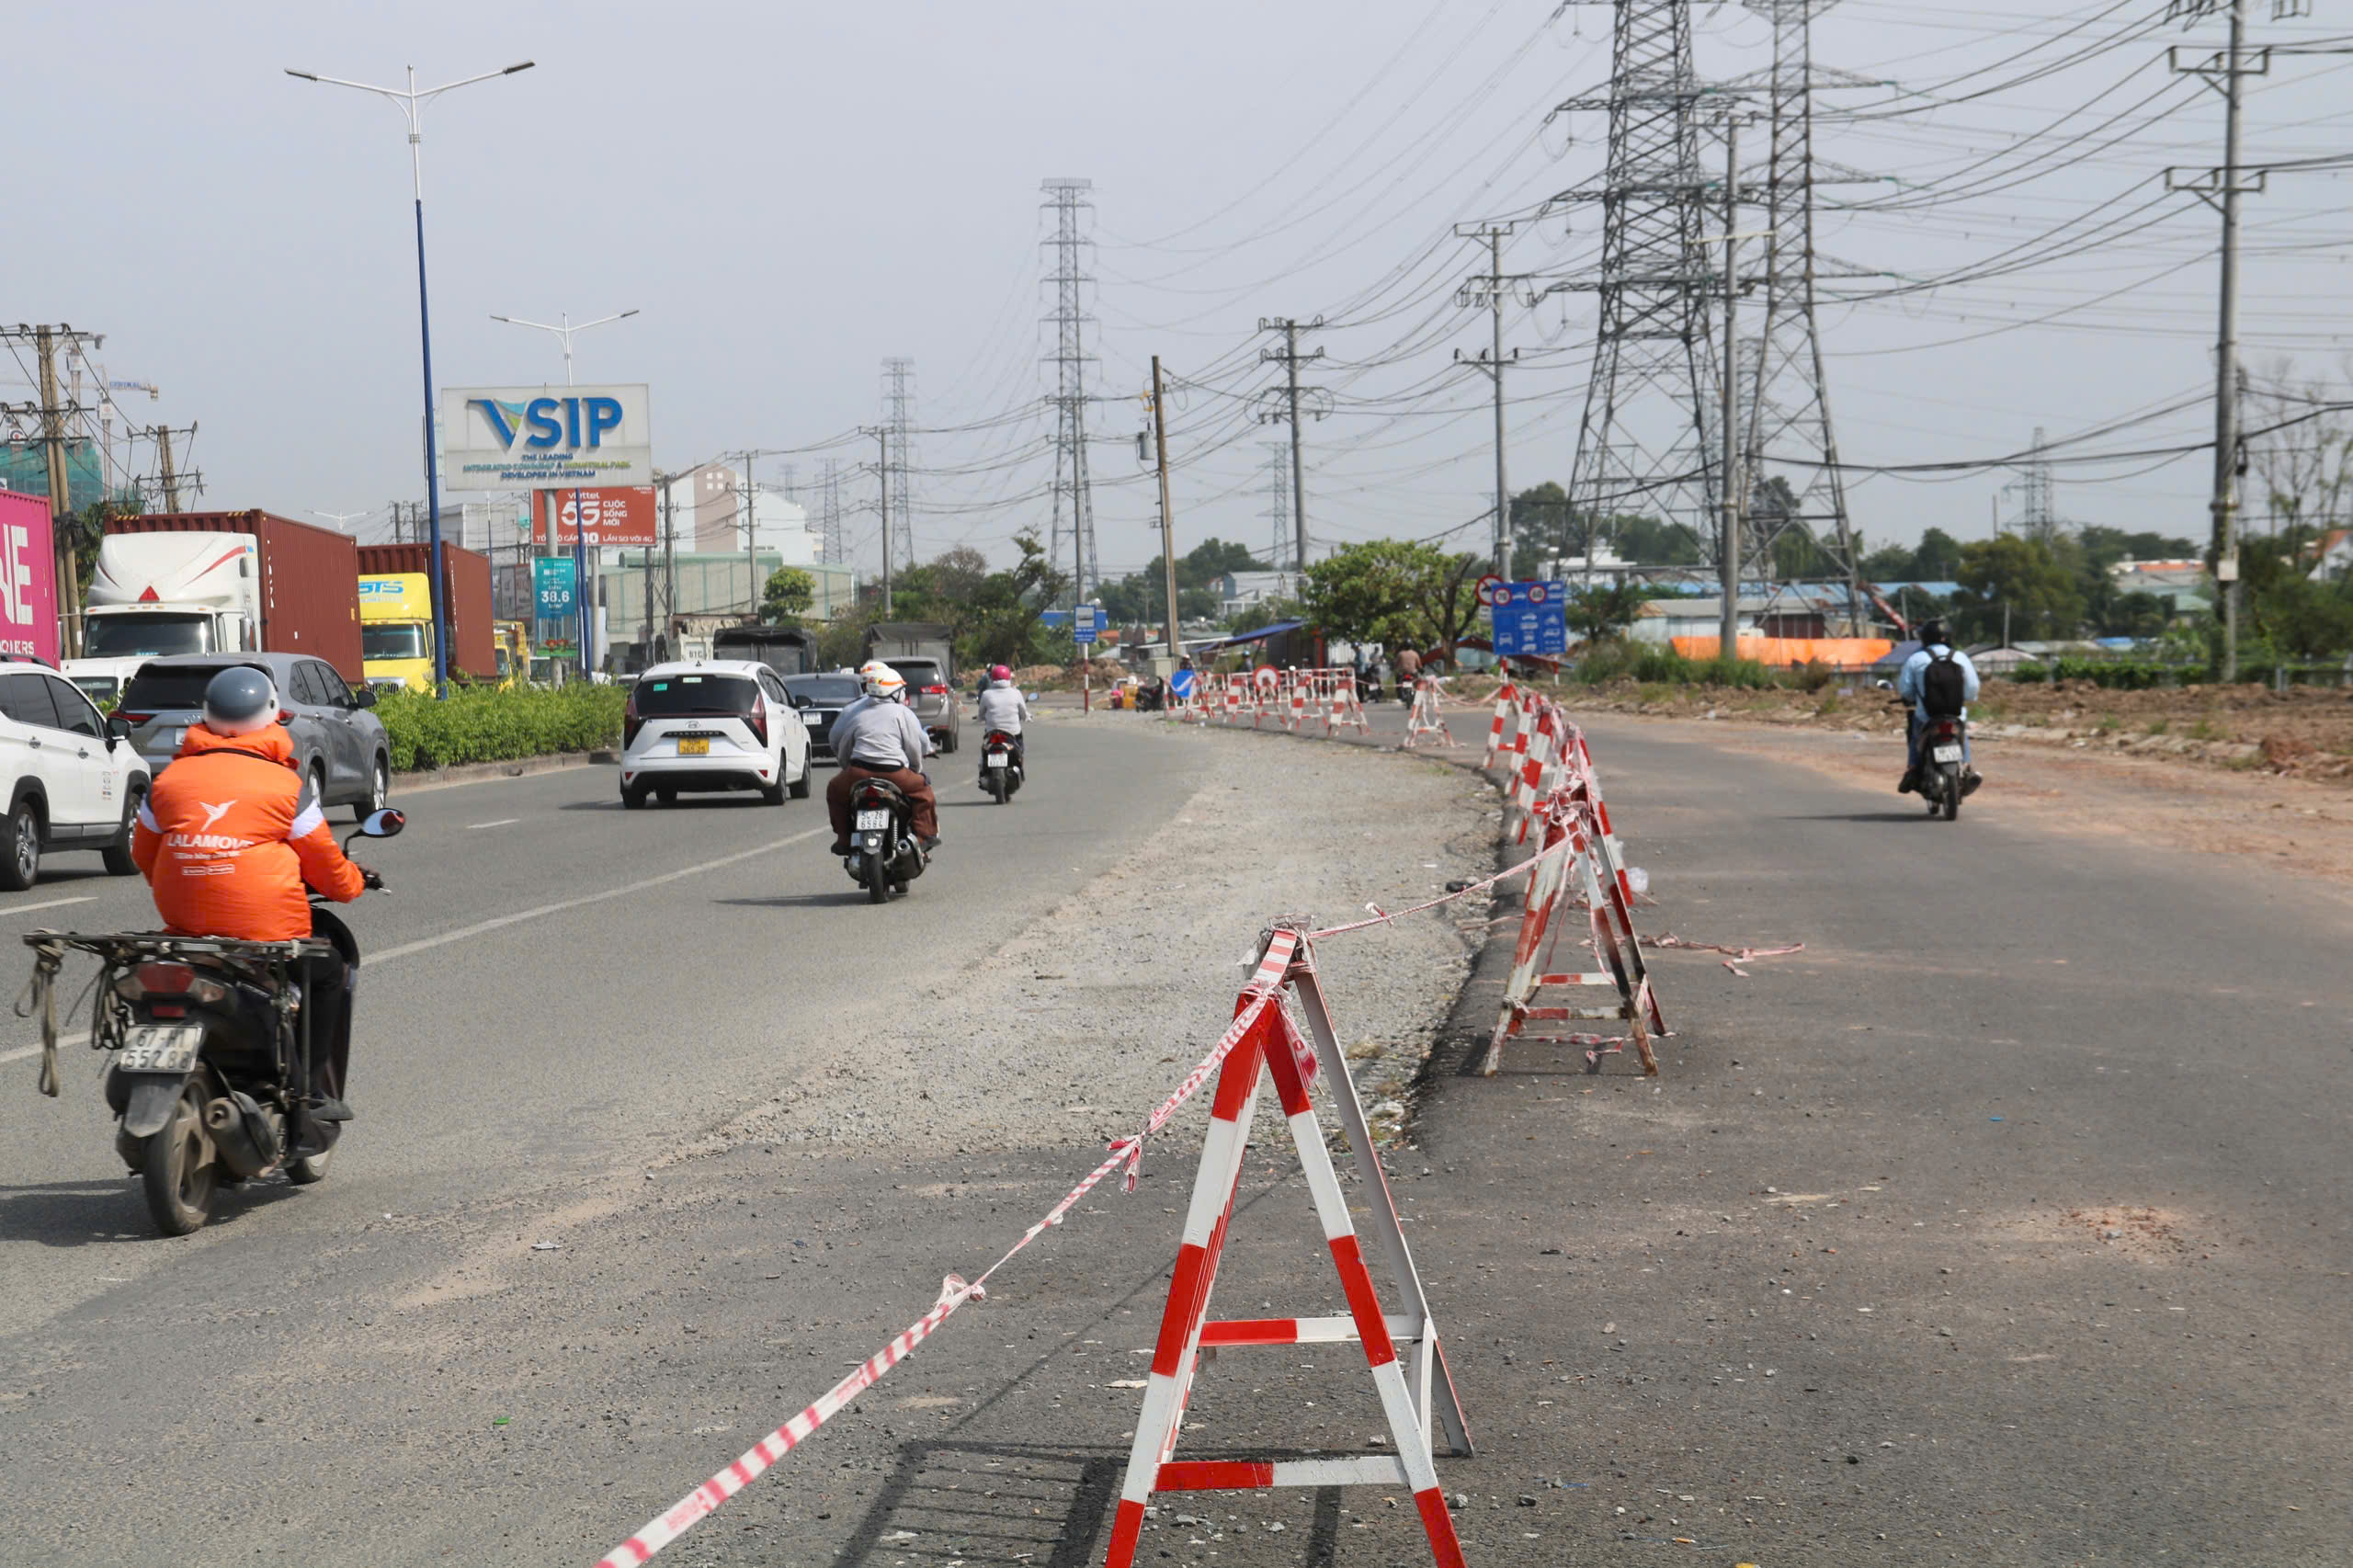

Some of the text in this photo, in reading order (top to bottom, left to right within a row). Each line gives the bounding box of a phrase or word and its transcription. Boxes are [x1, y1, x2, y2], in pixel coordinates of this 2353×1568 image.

[468, 397, 623, 449] VSIP
[559, 470, 597, 478] VIETNAM
[561, 501, 600, 527] 5G
[603, 507, 627, 517] SỐNG
[583, 532, 599, 543] 10
[540, 590, 570, 603] 38.6
